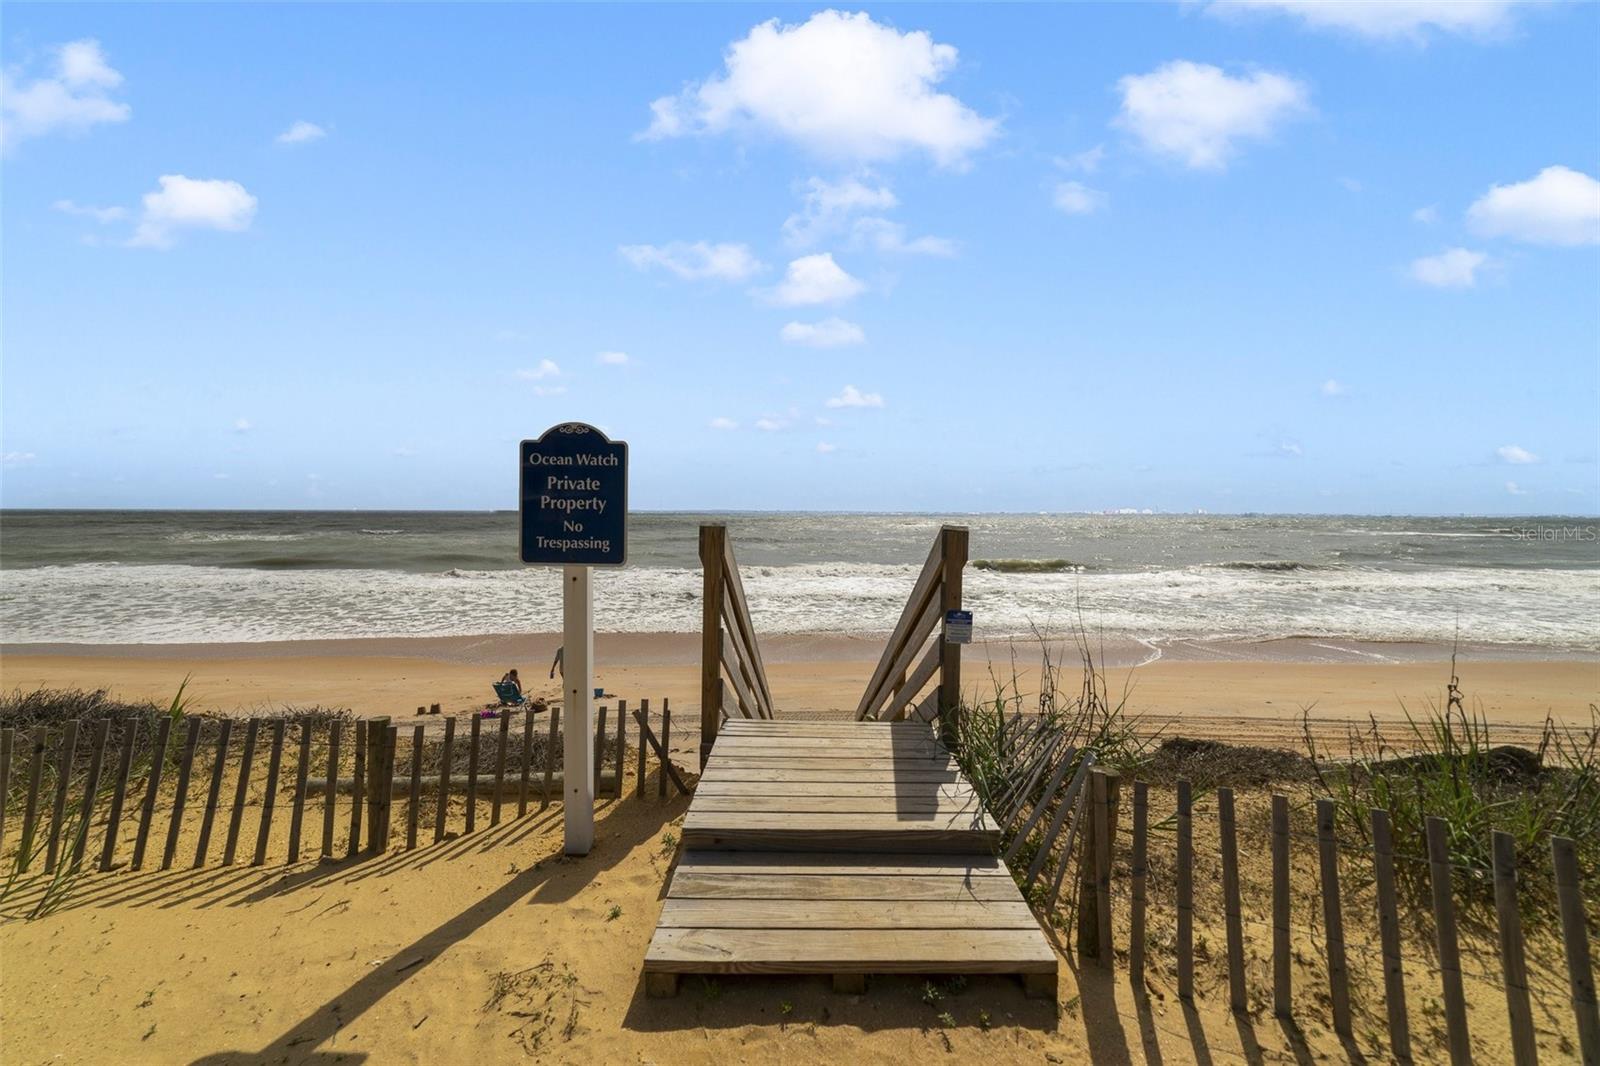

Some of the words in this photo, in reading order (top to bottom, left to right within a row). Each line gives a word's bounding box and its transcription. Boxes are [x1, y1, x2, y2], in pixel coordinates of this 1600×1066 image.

[529, 452, 573, 465] Ocean
[576, 453, 619, 466] Watch
[547, 475, 601, 491] Private
[540, 495, 607, 514] Property
[563, 520, 583, 533] No
[536, 536, 610, 553] Trespassing
